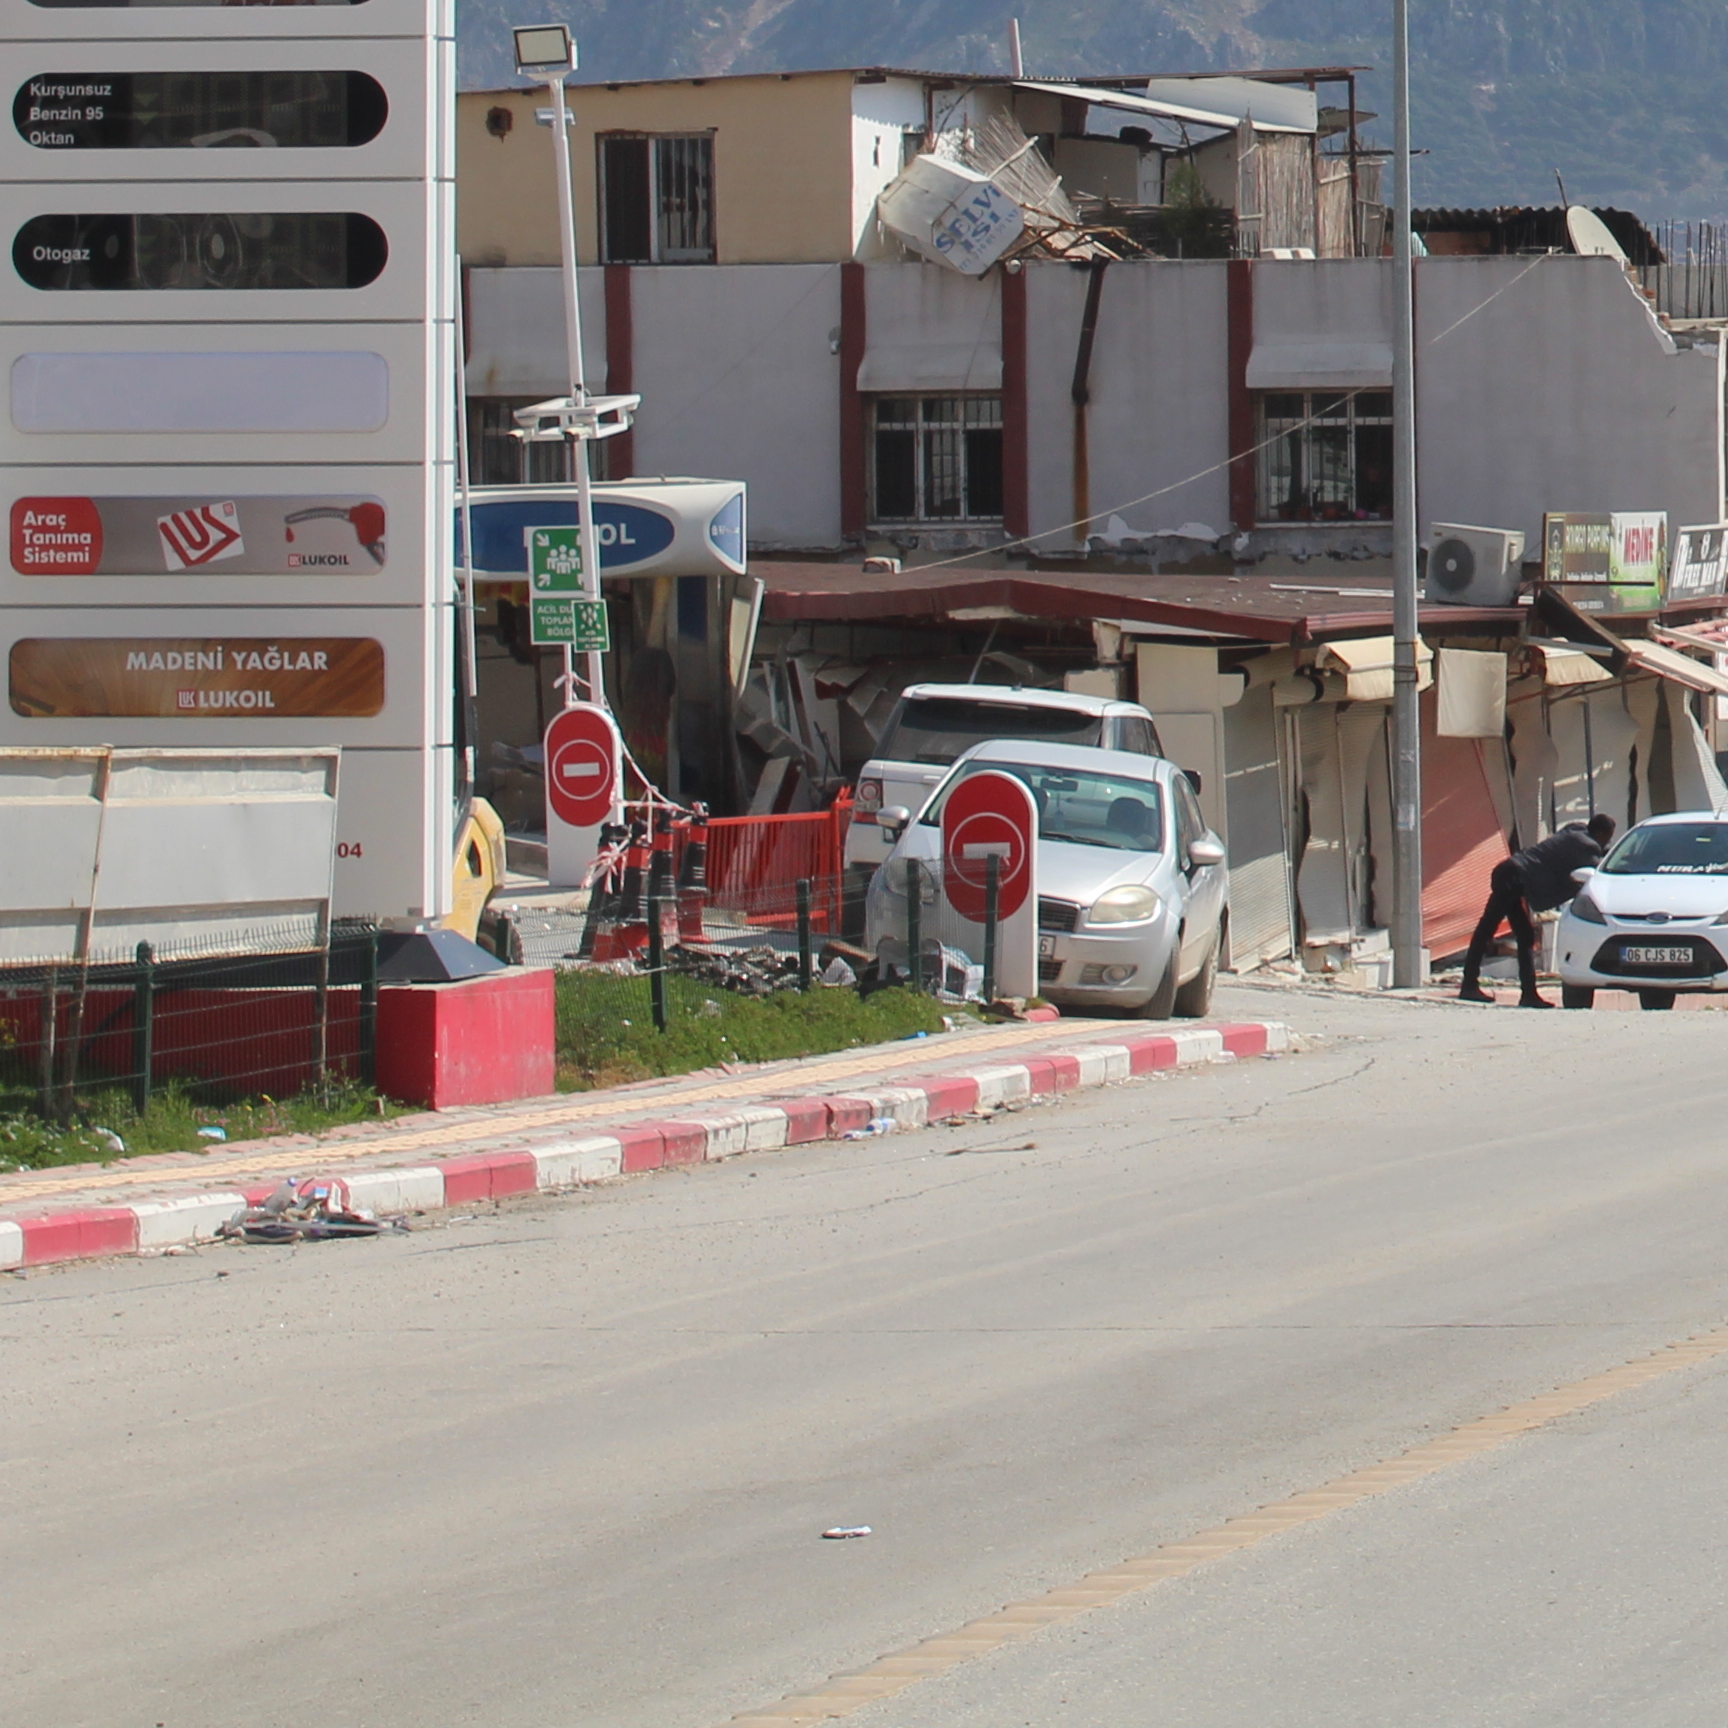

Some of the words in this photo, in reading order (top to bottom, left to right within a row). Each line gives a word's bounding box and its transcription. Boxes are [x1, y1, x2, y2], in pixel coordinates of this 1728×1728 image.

[30, 82, 112, 99] Kurşunsuz
[30, 106, 82, 121] Benzin
[85, 105, 104, 120] 95
[30, 131, 74, 146] Oktan
[33, 245, 90, 263] Otogaz
[22, 510, 67, 531] Araç
[23, 530, 92, 546] Tanıma
[23, 547, 91, 564] Sistemi
[301, 554, 349, 566] LUKOIL
[547, 625, 573, 636] BÖLG
[126, 645, 224, 671] MADENİ
[232, 645, 328, 671] YAĞLAR
[200, 690, 275, 708] LUKOIL
[1627, 949, 1641, 962] 06
[1644, 949, 1665, 962] CJS
[1669, 949, 1690, 962] 825
